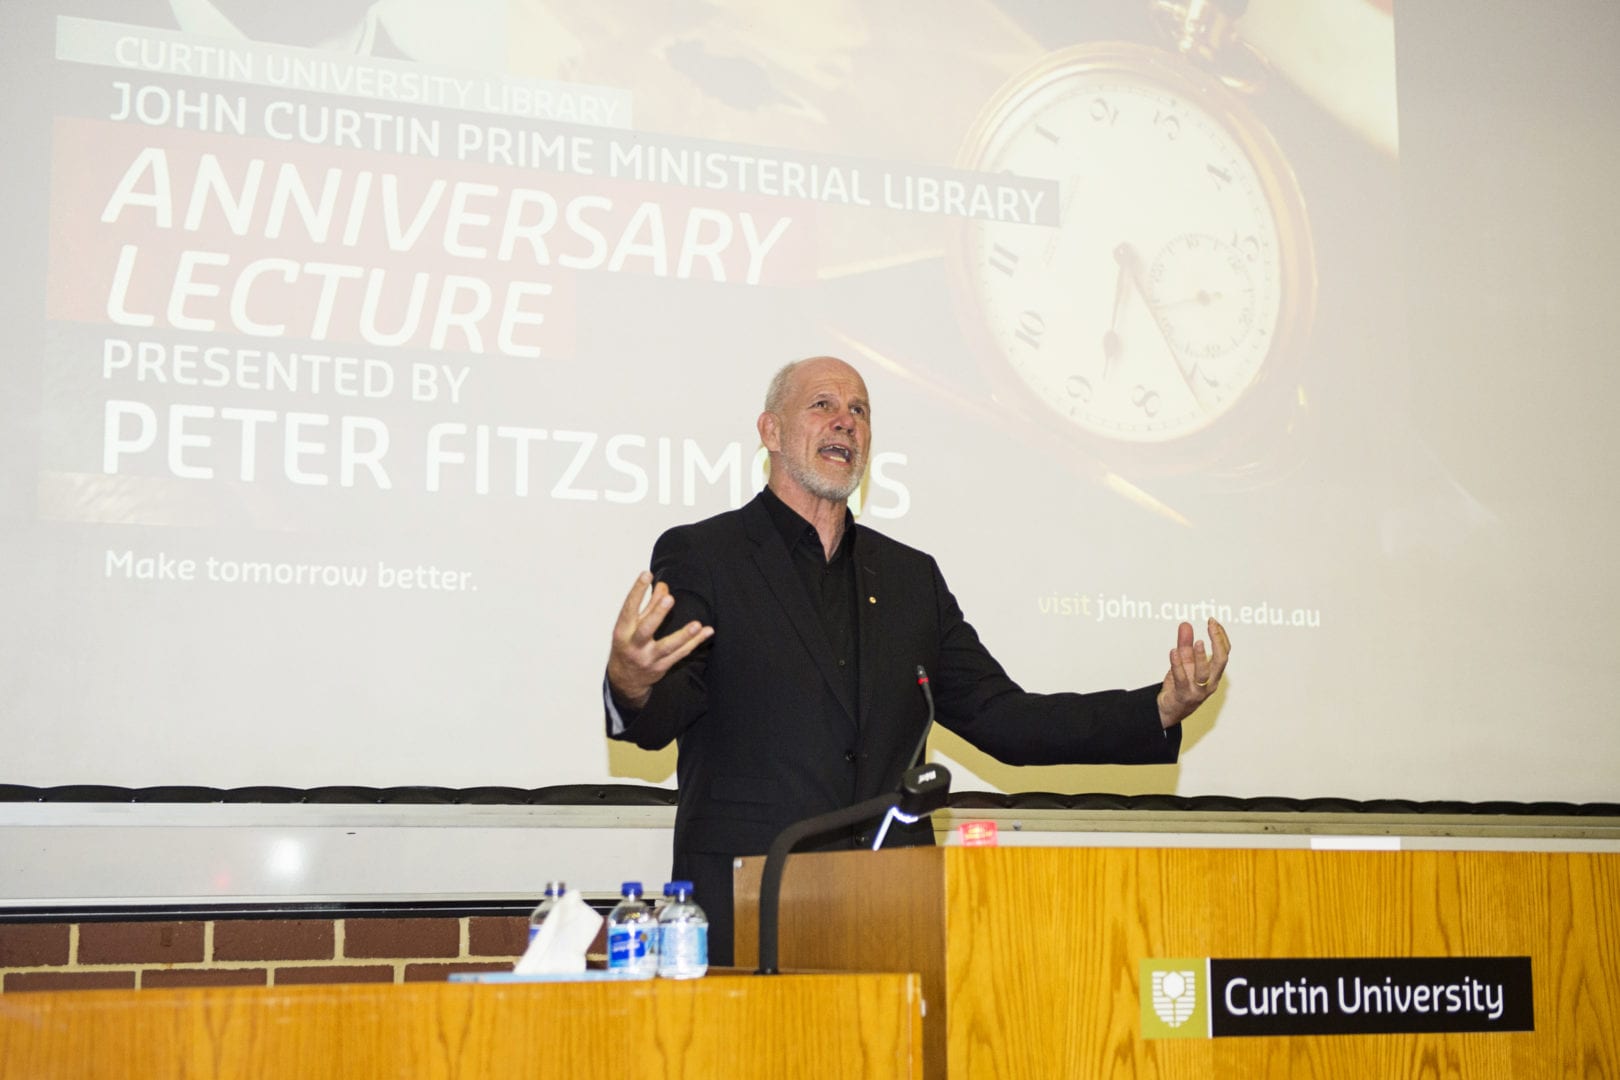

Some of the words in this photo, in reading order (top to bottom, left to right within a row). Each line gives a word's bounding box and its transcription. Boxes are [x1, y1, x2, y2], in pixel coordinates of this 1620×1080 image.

[113, 36, 254, 84] CURTIN
[265, 54, 474, 107] UNIVERSITY
[482, 83, 619, 125] LIBRARY
[109, 81, 247, 135] JOHN
[264, 101, 441, 157] CURTIN
[457, 123, 594, 175] PRIME
[609, 140, 871, 206] MINISTERIAL
[883, 172, 1046, 225] LIBRARY
[101, 146, 792, 286] ANNIVERSARY
[105, 243, 553, 359] LECTURE
[102, 338, 395, 399] PRESENTED
[411, 363, 471, 404] BY
[102, 399, 392, 490] PETER
[425, 422, 912, 520] FITZSIMS
[104, 549, 197, 582] Make
[207, 555, 368, 588] tomorrow
[378, 561, 480, 592] better.
[1038, 592, 1092, 617] visit
[1096, 593, 1321, 628] john.curtin.edu.au
[1224, 977, 1329, 1016] Curtin
[1337, 974, 1505, 1020] University
